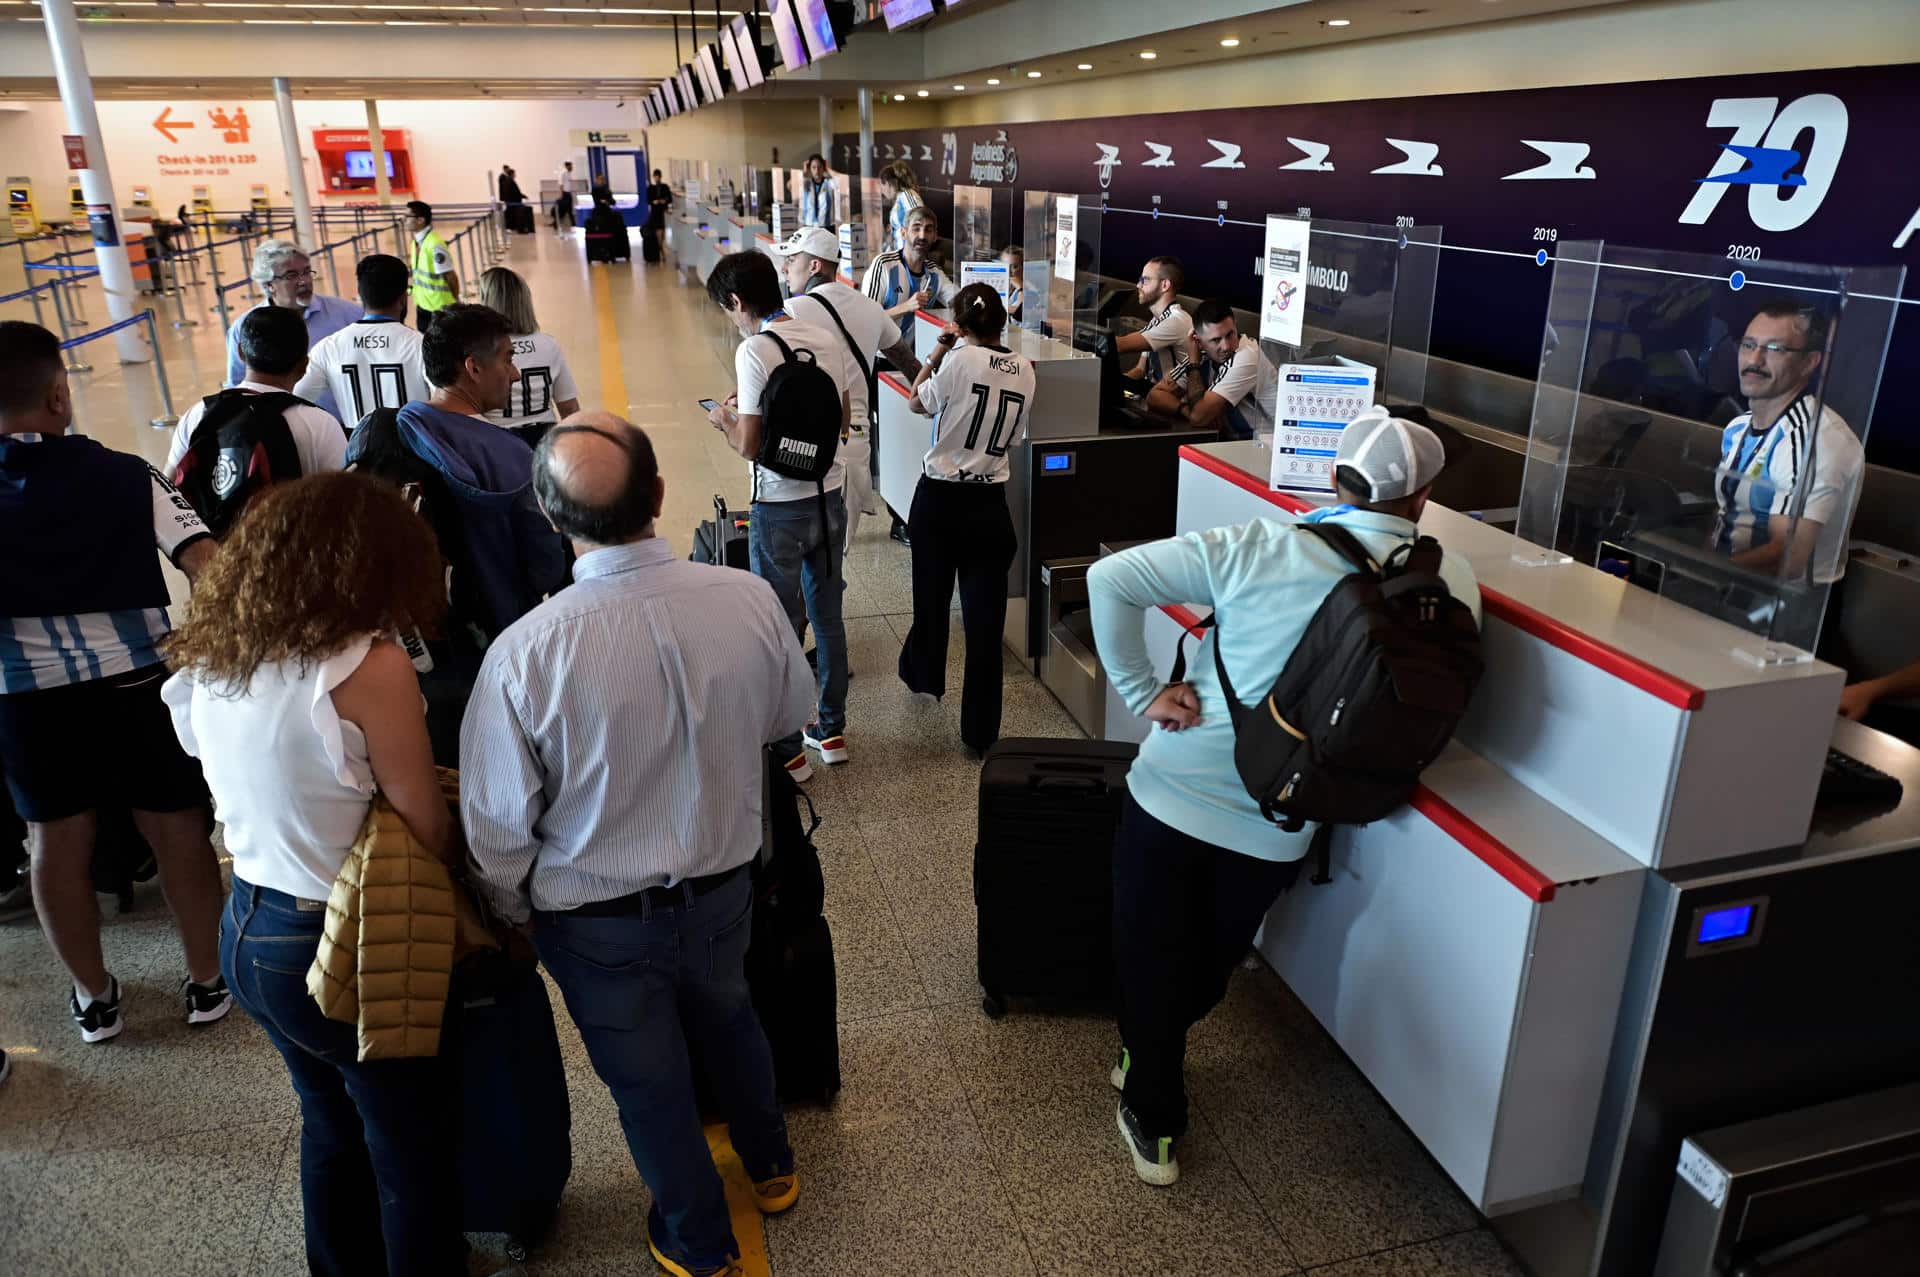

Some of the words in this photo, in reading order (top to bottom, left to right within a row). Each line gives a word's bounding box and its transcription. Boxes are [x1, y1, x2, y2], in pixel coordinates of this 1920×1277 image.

[1678, 93, 1849, 232] 70
[1396, 215, 1414, 228] 2010
[1533, 228, 1557, 242] 2019
[1727, 244, 1761, 262] 2020
[1307, 261, 1348, 292] ÍMBOLO
[353, 335, 390, 349] MESSI
[512, 340, 536, 354] ESSI
[990, 355, 1020, 376] MESSI
[341, 363, 408, 421] 10
[964, 382, 1025, 457] 10
